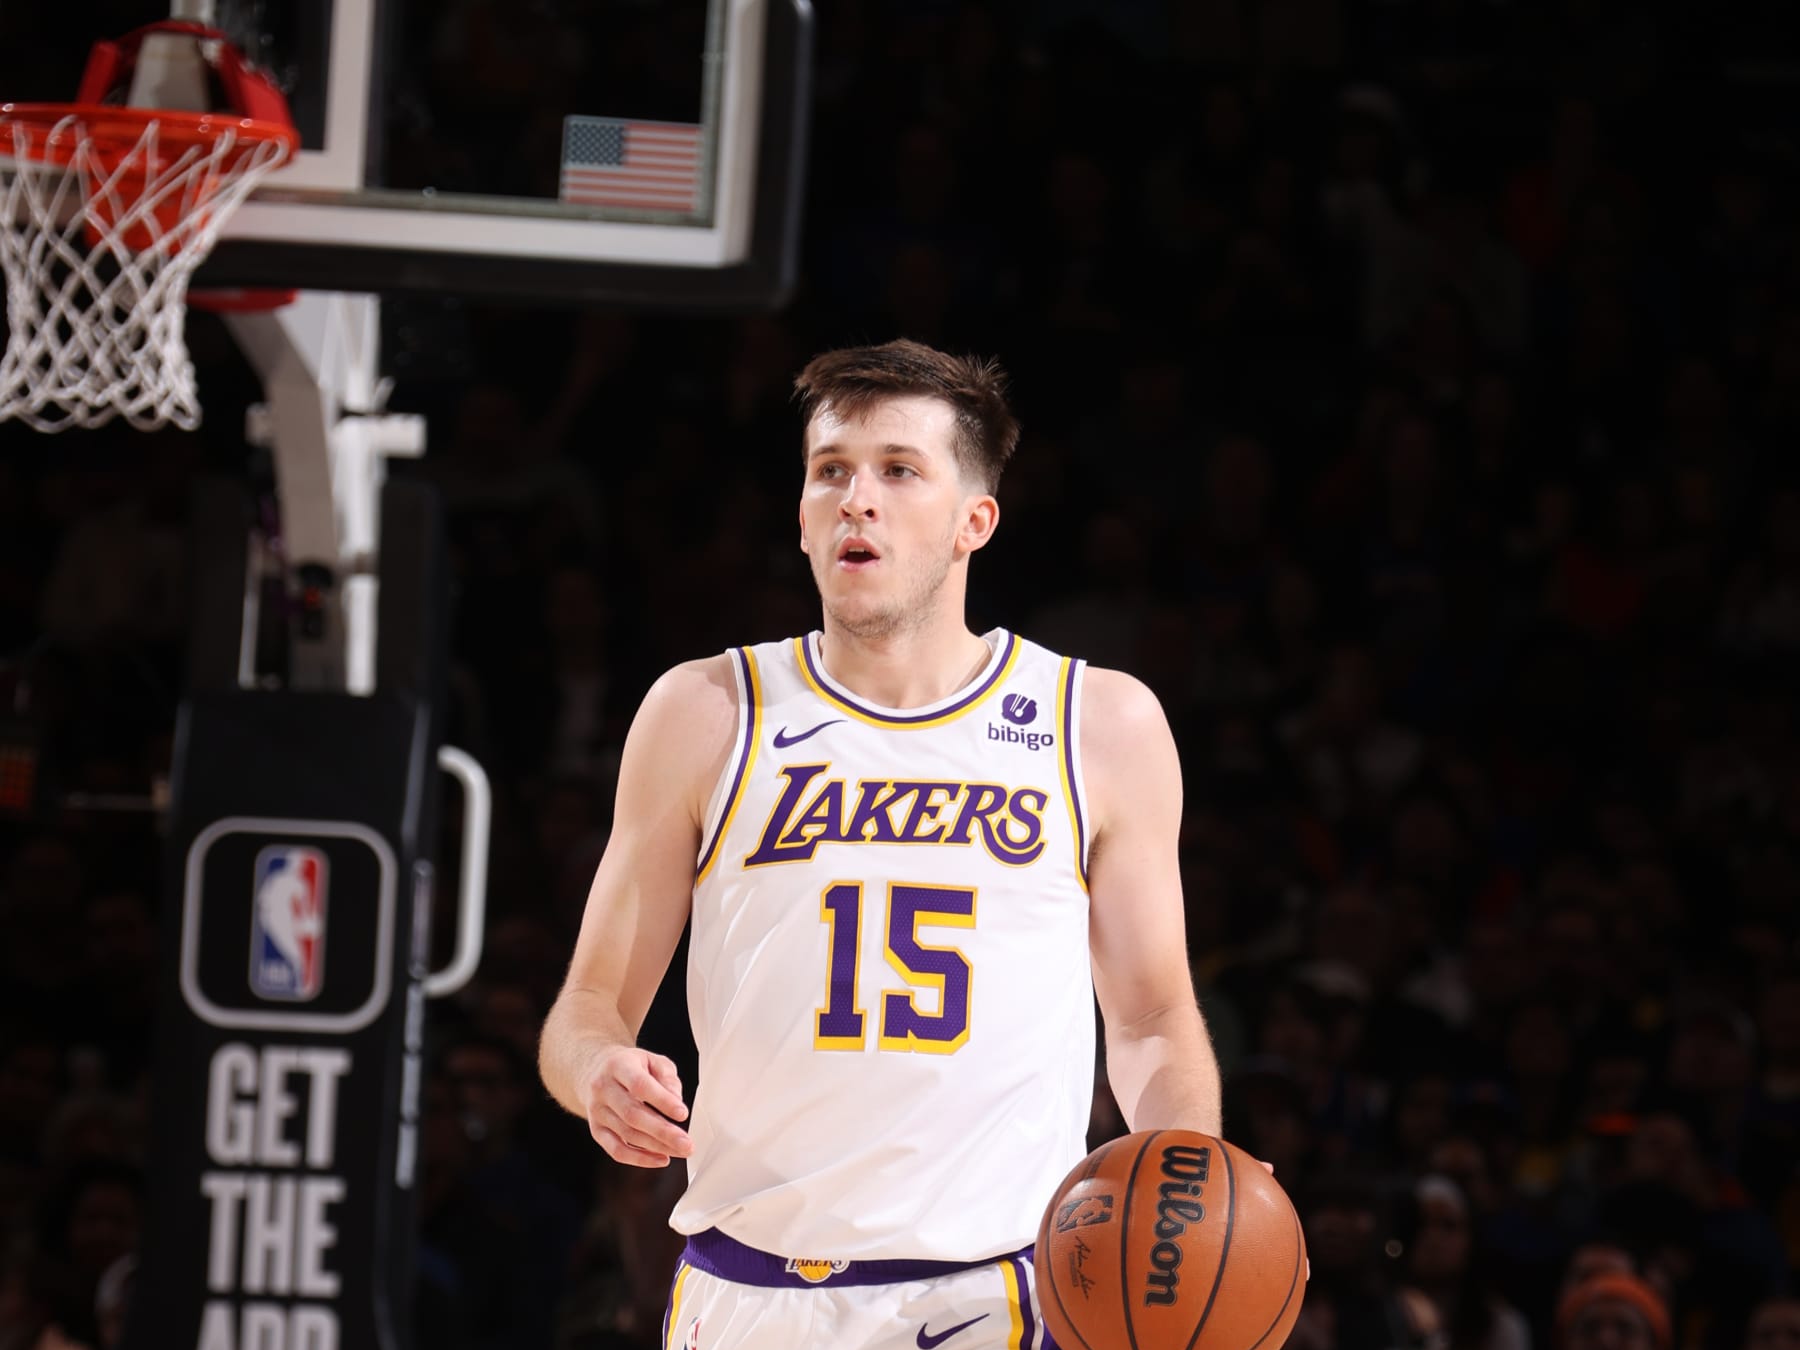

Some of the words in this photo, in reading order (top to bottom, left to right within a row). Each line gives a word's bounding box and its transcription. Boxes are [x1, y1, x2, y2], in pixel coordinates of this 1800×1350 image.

[988, 722, 1053, 751] bibigo
[743, 761, 1049, 868] LAKERS
[814, 881, 977, 1055] 15
[206, 1043, 349, 1167] GET
[201, 1173, 345, 1296] THE
[1144, 1146, 1211, 1307] Wilson
